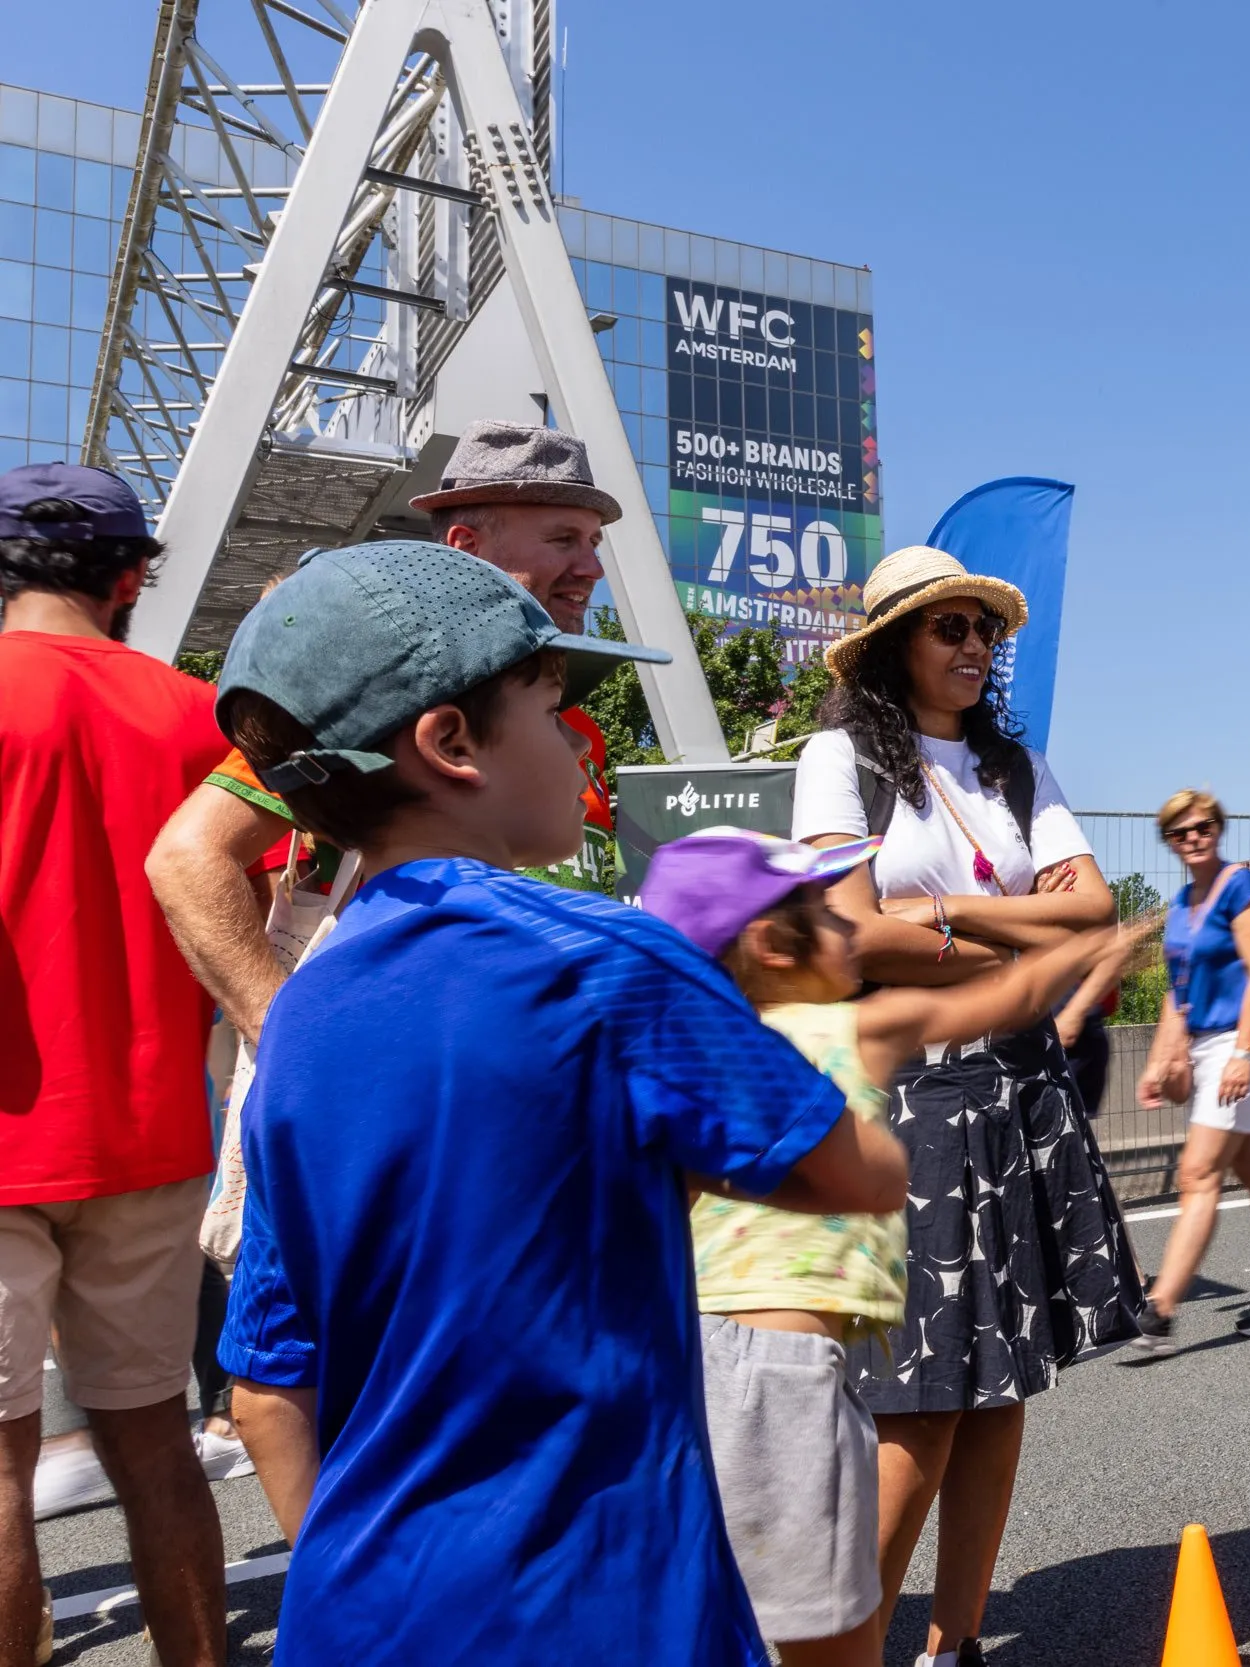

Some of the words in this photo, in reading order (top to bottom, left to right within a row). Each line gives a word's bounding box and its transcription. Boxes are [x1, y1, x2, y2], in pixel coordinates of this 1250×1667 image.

[673, 290, 796, 348] WFC
[675, 339, 796, 373] AMSTERDAM
[677, 430, 739, 459] 500+
[746, 439, 843, 475] BRANDS
[676, 460, 751, 487] FASHION
[755, 471, 857, 501] WHOLESALE
[702, 507, 848, 589] 750
[700, 589, 846, 637] AMSTERDAM
